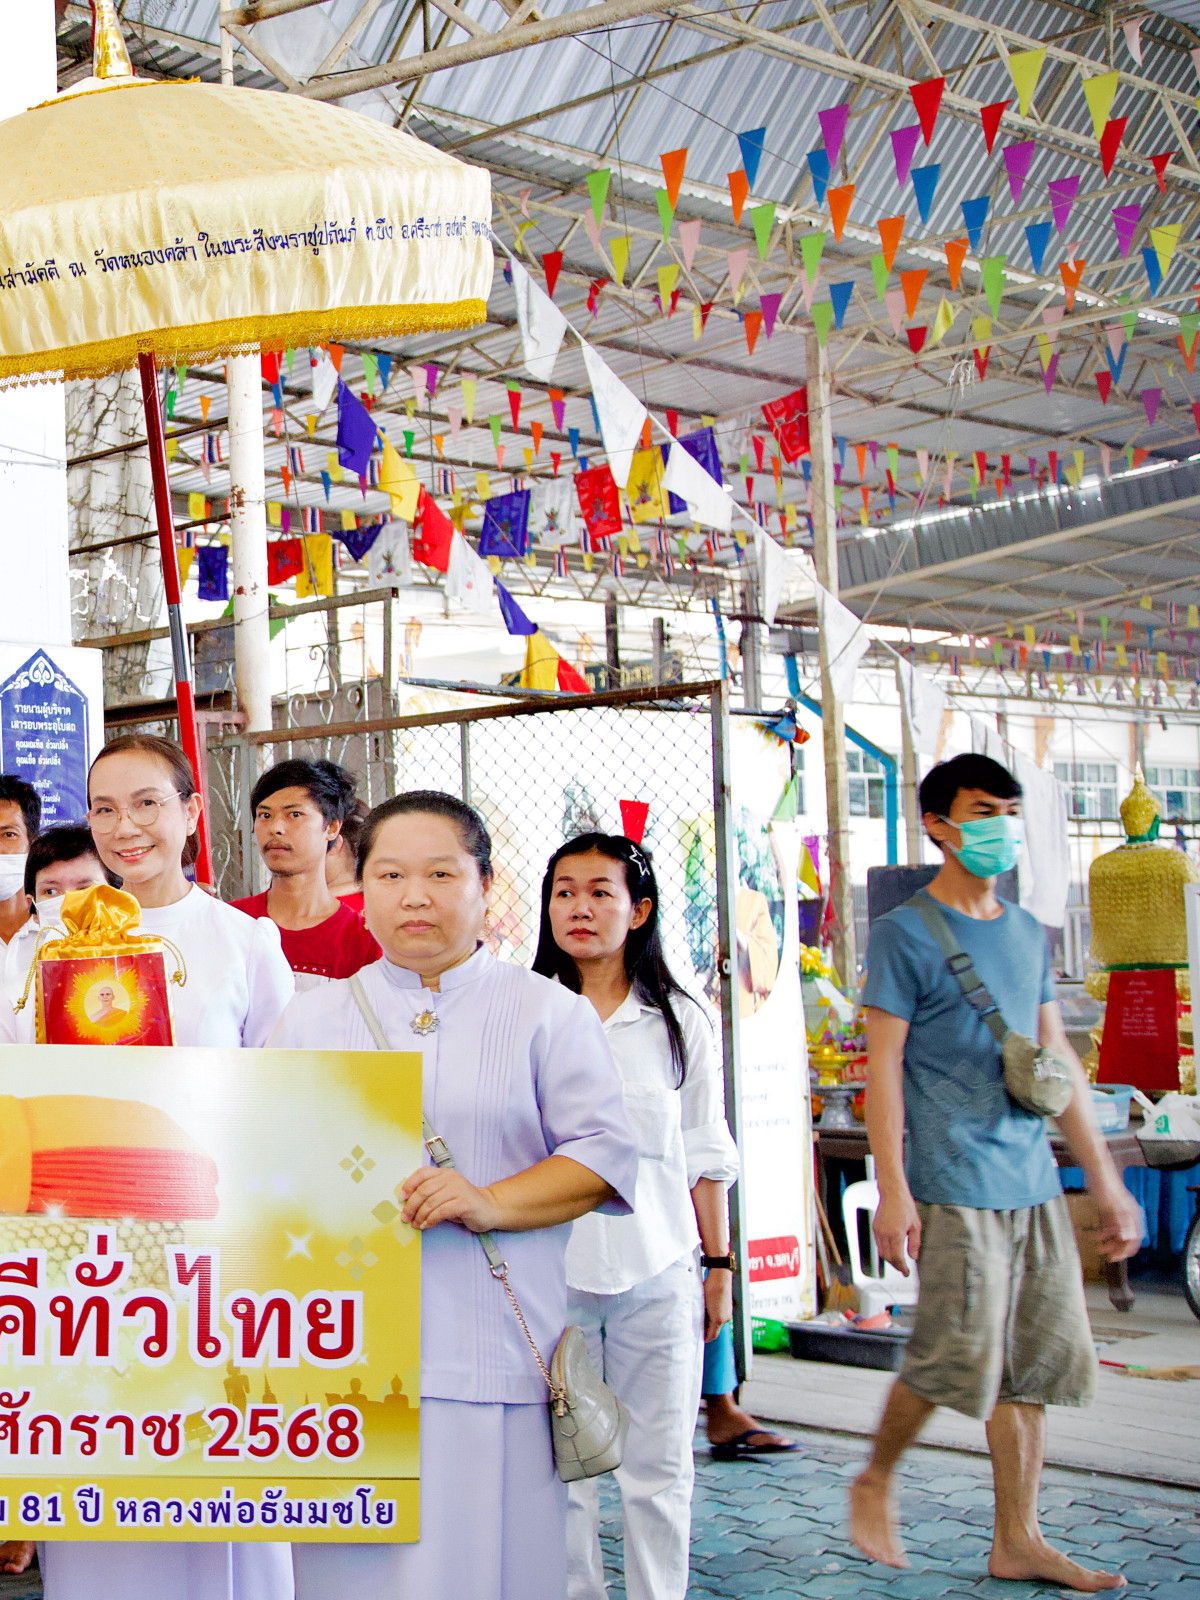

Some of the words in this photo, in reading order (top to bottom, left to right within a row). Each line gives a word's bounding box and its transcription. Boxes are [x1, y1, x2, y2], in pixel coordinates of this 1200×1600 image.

[69, 261, 87, 278] ณ
[95, 238, 198, 273] วัดหนองคล้า
[207, 1406, 362, 1460] 2568
[21, 1495, 63, 1524] 81
[77, 1488, 102, 1525] ปี
[115, 1487, 396, 1526] หลวงพ่อธัมมชโย
